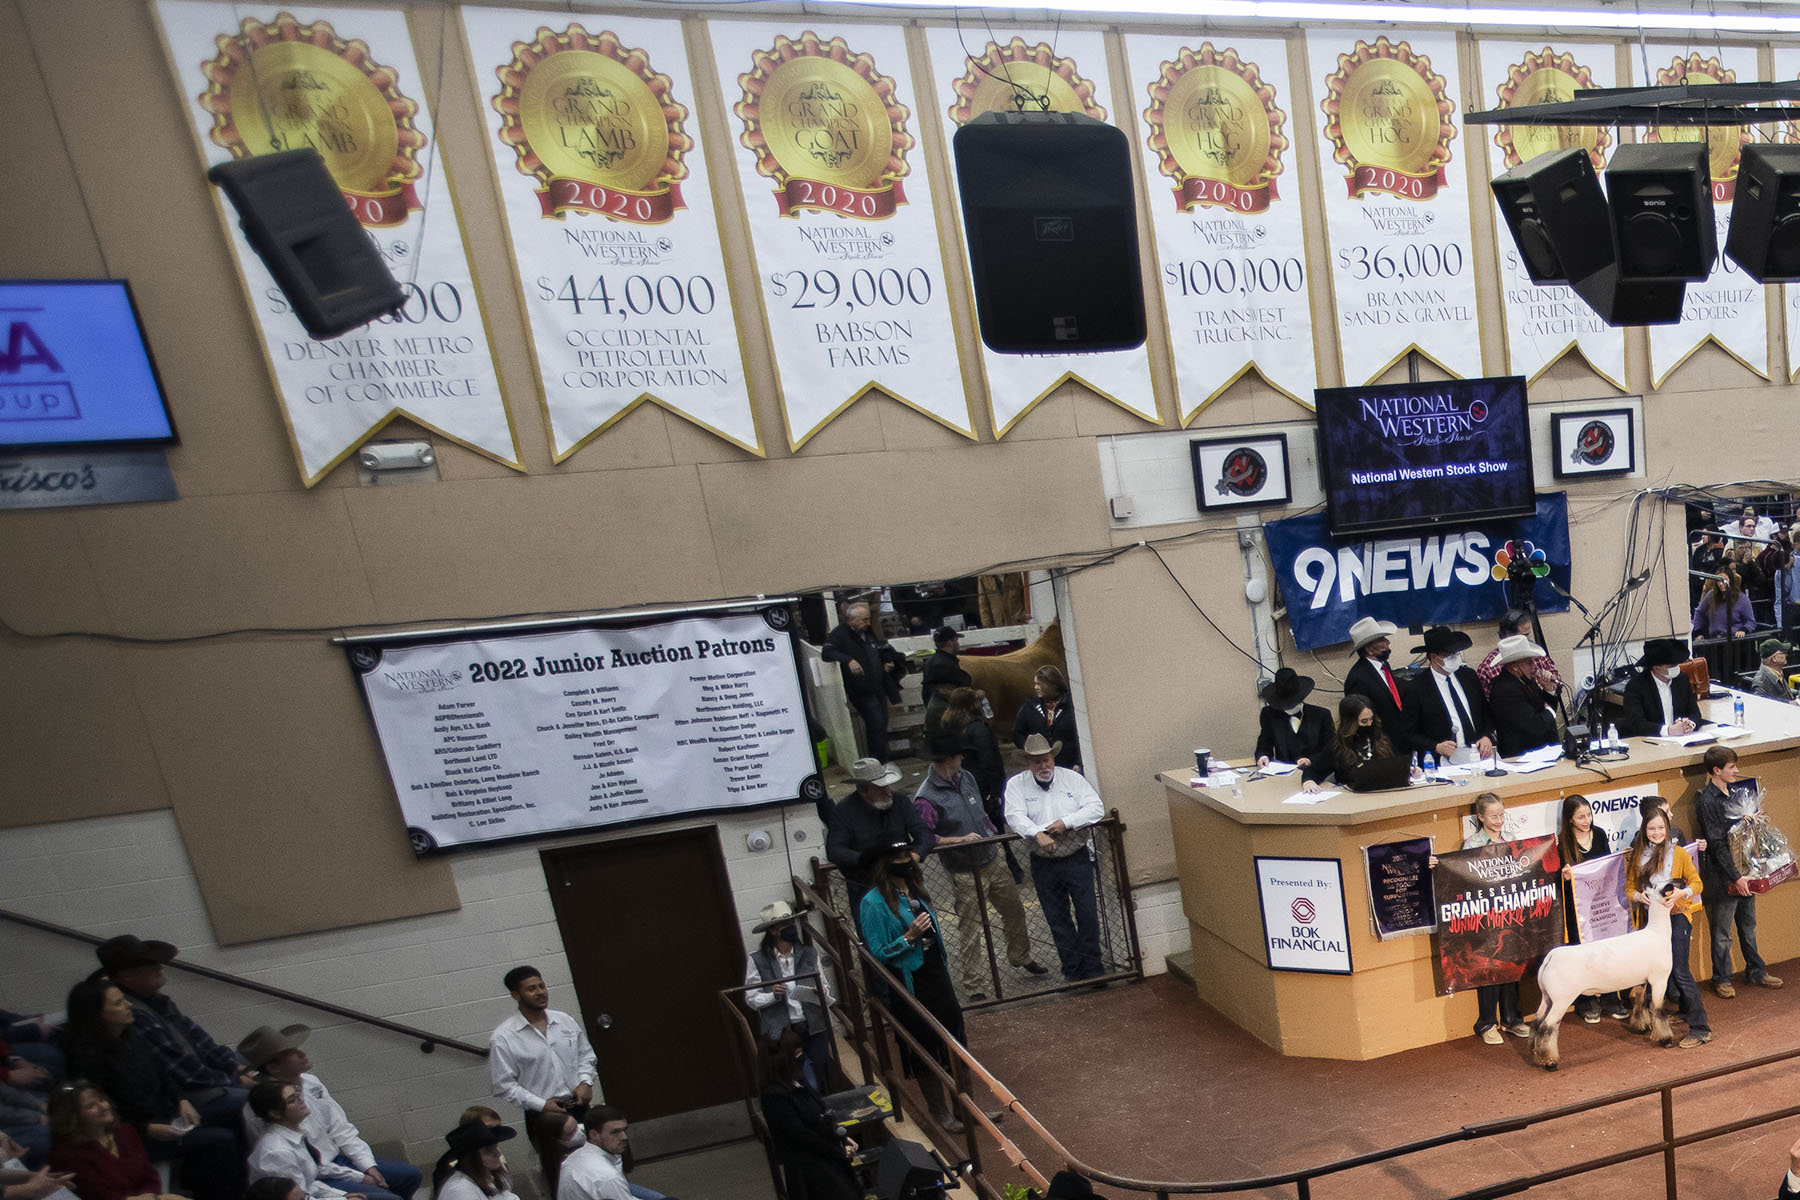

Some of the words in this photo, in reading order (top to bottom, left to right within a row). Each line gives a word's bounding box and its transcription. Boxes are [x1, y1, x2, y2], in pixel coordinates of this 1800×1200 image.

[552, 98, 631, 116] GRAND
[788, 102, 859, 118] GRAND
[1188, 107, 1244, 122] GRAND
[791, 118, 861, 129] CHAMPION
[559, 126, 636, 151] LAMB
[795, 129, 862, 151] GOAT
[1196, 131, 1241, 150] HOG
[1370, 127, 1410, 145] HOG
[1365, 168, 1424, 198] 2020
[566, 182, 652, 220] 2020
[799, 182, 877, 216] 2020
[1194, 180, 1253, 211] 2020
[1361, 206, 1419, 220] NATIONAL
[797, 226, 873, 242] NATIONAL
[1372, 218, 1426, 231] WESTERN
[563, 228, 648, 245] NATIONAL
[812, 239, 884, 254] WESTERN
[580, 242, 660, 259] WESTERN
[1338, 243, 1463, 285] $36,000
[1165, 257, 1304, 300] $100,000
[537, 274, 716, 323] $44,000
[770, 267, 932, 315] $29,000
[1367, 289, 1446, 308] BRANNAN
[1344, 309, 1391, 327] SAND
[1395, 309, 1411, 324] &
[1414, 306, 1473, 323] GRAVEL
[565, 328, 711, 348] OCCIDENTAL
[815, 319, 913, 344] BABSON
[284, 339, 387, 361] DENVER
[393, 335, 474, 357] METRO
[577, 349, 708, 368] PETROLEUM
[827, 345, 911, 368] FARMS
[329, 359, 444, 381] CHAMBER
[562, 368, 729, 389] CORPORATION
[305, 386, 336, 405] OF
[344, 378, 481, 403] COMMERCE
[1358, 394, 1460, 421] NATIONAL
[1378, 414, 1473, 438] WESTERN
[1412, 432, 1441, 447] Stock
[1443, 431, 1473, 445] Show
[0, 462, 97, 493] risco's
[1351, 469, 1398, 485] National
[1398, 467, 1444, 481] Western
[1446, 463, 1477, 476] Stock
[1478, 461, 1508, 474] Show
[1293, 531, 1491, 610] 9NEWS
[469, 658, 529, 683] 2022
[532, 653, 605, 677] Junior
[610, 643, 694, 669] Auction
[696, 636, 776, 659] Patrons
[384, 669, 444, 684] NATIONAL
[726, 670, 757, 679] Corporation
[1592, 794, 1639, 815] 9NEWS
[1467, 855, 1517, 873] NATIONAL
[1477, 863, 1523, 879] WESTERN
[1270, 877, 1314, 888] Presented
[1316, 879, 1333, 890] By:
[1466, 879, 1537, 901] RESERVE
[1441, 898, 1490, 922] GRAND
[1494, 883, 1557, 914] CHAMPION
[1291, 926, 1321, 939] BOK
[1449, 913, 1485, 935] JUNIOR
[1271, 937, 1346, 953] FINANCIAL
